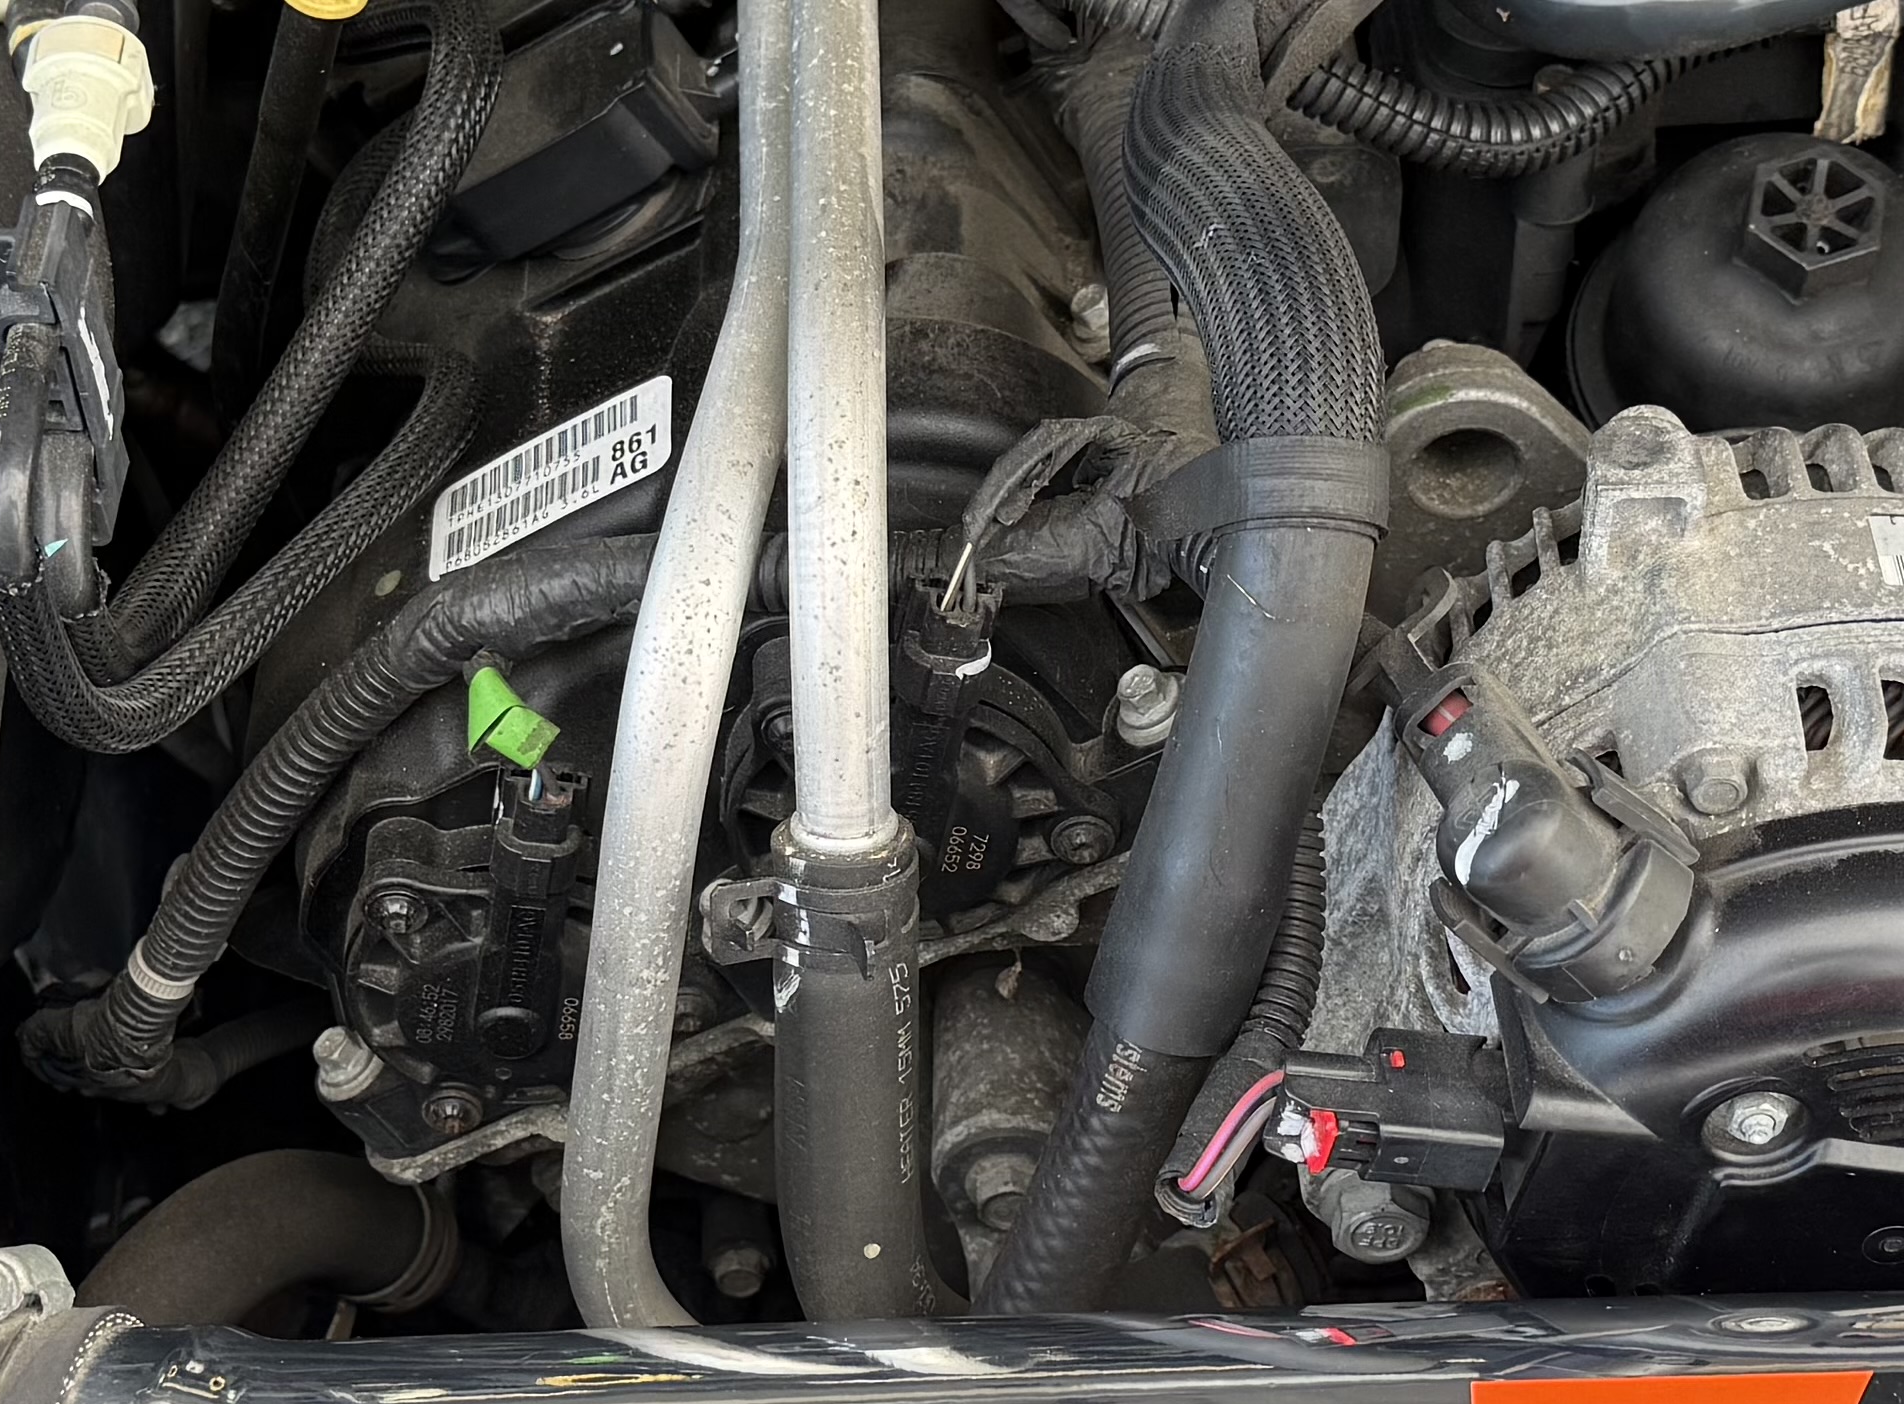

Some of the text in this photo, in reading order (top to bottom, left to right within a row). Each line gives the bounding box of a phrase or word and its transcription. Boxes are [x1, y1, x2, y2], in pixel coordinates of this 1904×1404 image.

[611, 423, 658, 462] 861
[610, 451, 649, 485] AG
[941, 826, 968, 873] 06652
[965, 834, 990, 871] 7298
[889, 962, 913, 1016] 575
[558, 997, 580, 1040] 06658
